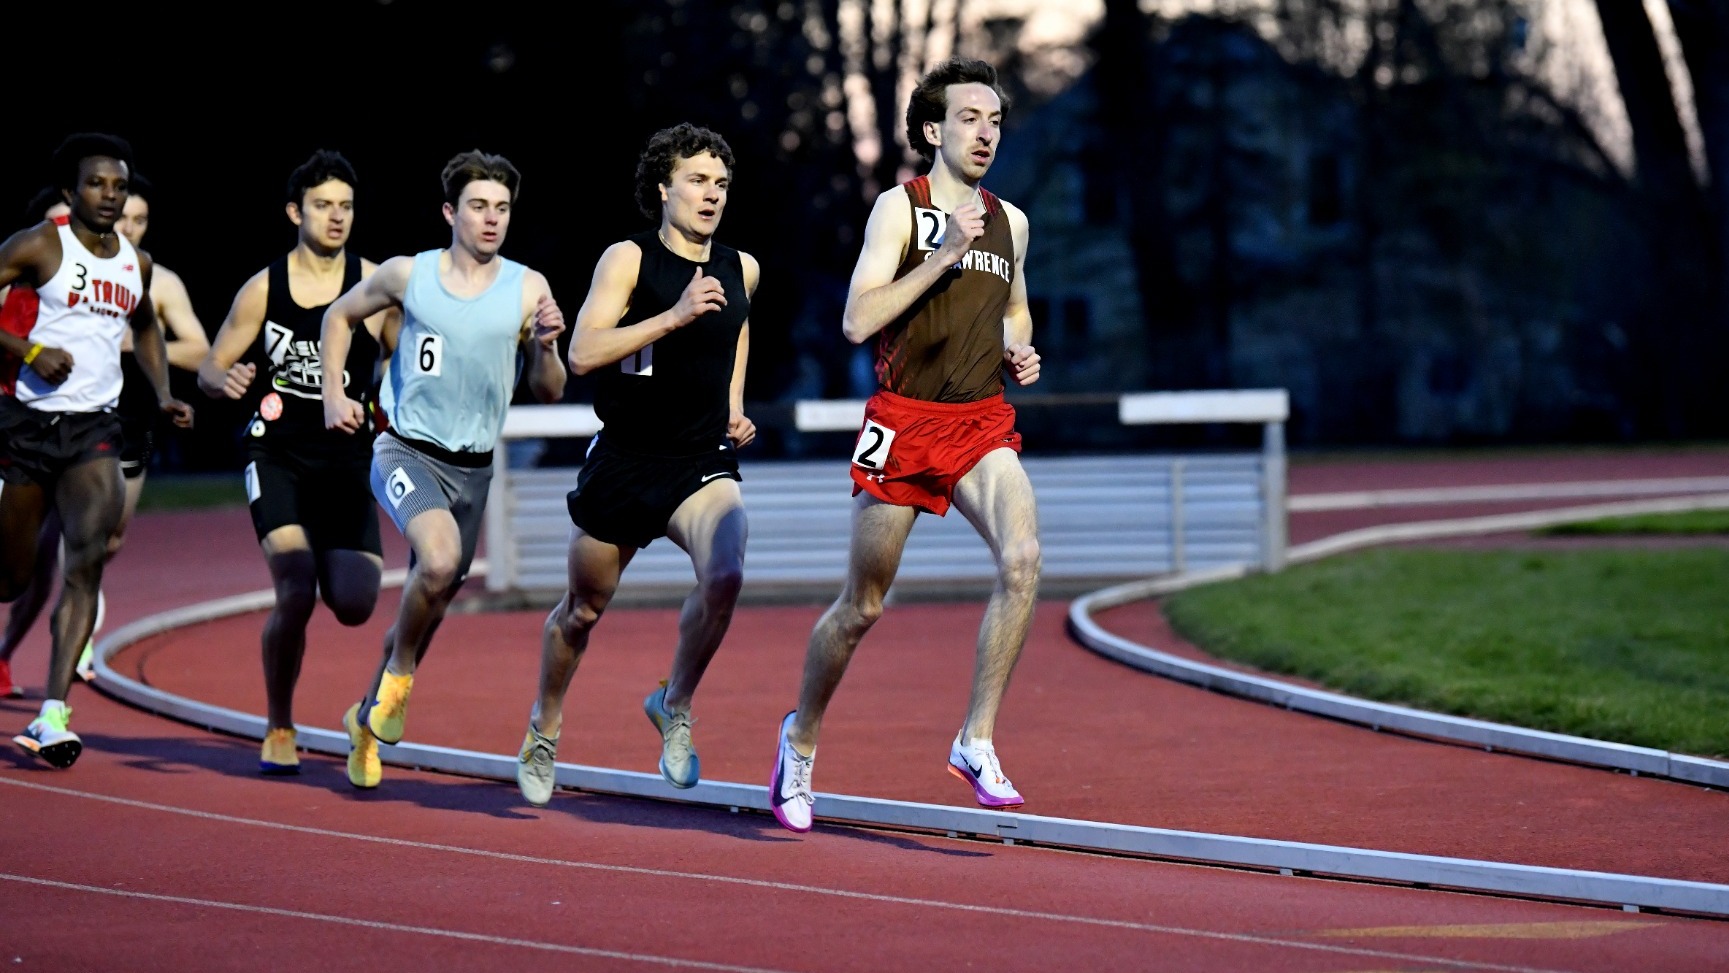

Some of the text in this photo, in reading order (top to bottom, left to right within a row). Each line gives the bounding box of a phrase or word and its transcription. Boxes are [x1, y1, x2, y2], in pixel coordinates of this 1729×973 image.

[922, 212, 942, 249] 2
[71, 263, 87, 291] 3
[951, 249, 1011, 283] WRENCE
[267, 327, 285, 357] 7
[419, 336, 435, 372] 6
[857, 426, 884, 468] 2
[389, 474, 406, 500] 6
